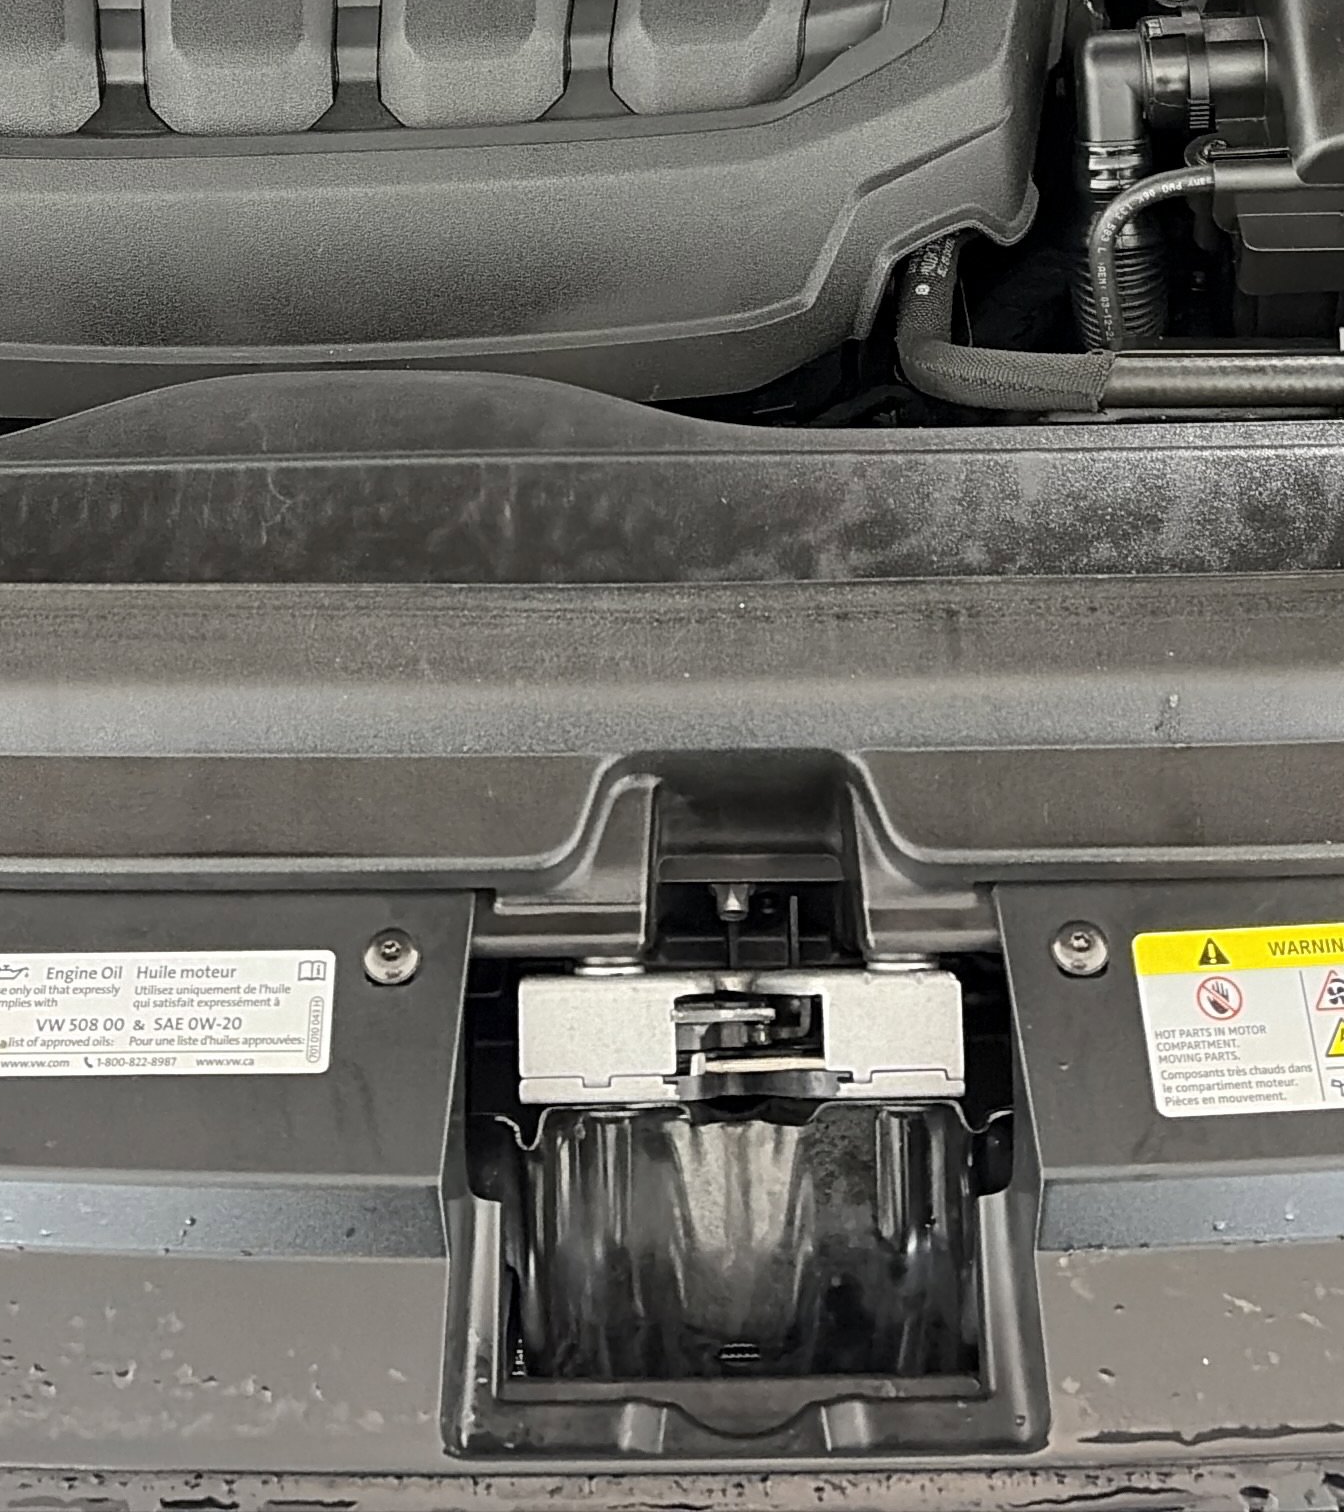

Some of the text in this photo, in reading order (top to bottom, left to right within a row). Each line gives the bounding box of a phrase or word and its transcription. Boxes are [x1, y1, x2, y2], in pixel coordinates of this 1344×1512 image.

[46, 966, 123, 984] Engine Oil
[136, 966, 236, 979] Huile moteur
[9, 985, 31, 997] only
[33, 985, 47, 995] oil
[48, 985, 70, 995] that
[72, 984, 120, 997] expressly
[134, 983, 291, 998] Utilisez uniquement de l'huile
[34, 997, 58, 1008] with
[36, 1017, 243, 1031] VW 508 00 & SAE 0W-20
[1155, 1024, 1267, 1039] HOT PARTS IN MOTOR
[8, 1037, 25, 1047] list
[26, 1037, 39, 1047] of
[40, 1036, 90, 1050] approved
[92, 1036, 114, 1047] oils:
[1156, 1039, 1240, 1052] COMPARTMENT.
[0, 1057, 254, 1068] www.vw.com 1-800-822-8987 www.vw.ca
[1158, 1053, 1202, 1064] MOVING
